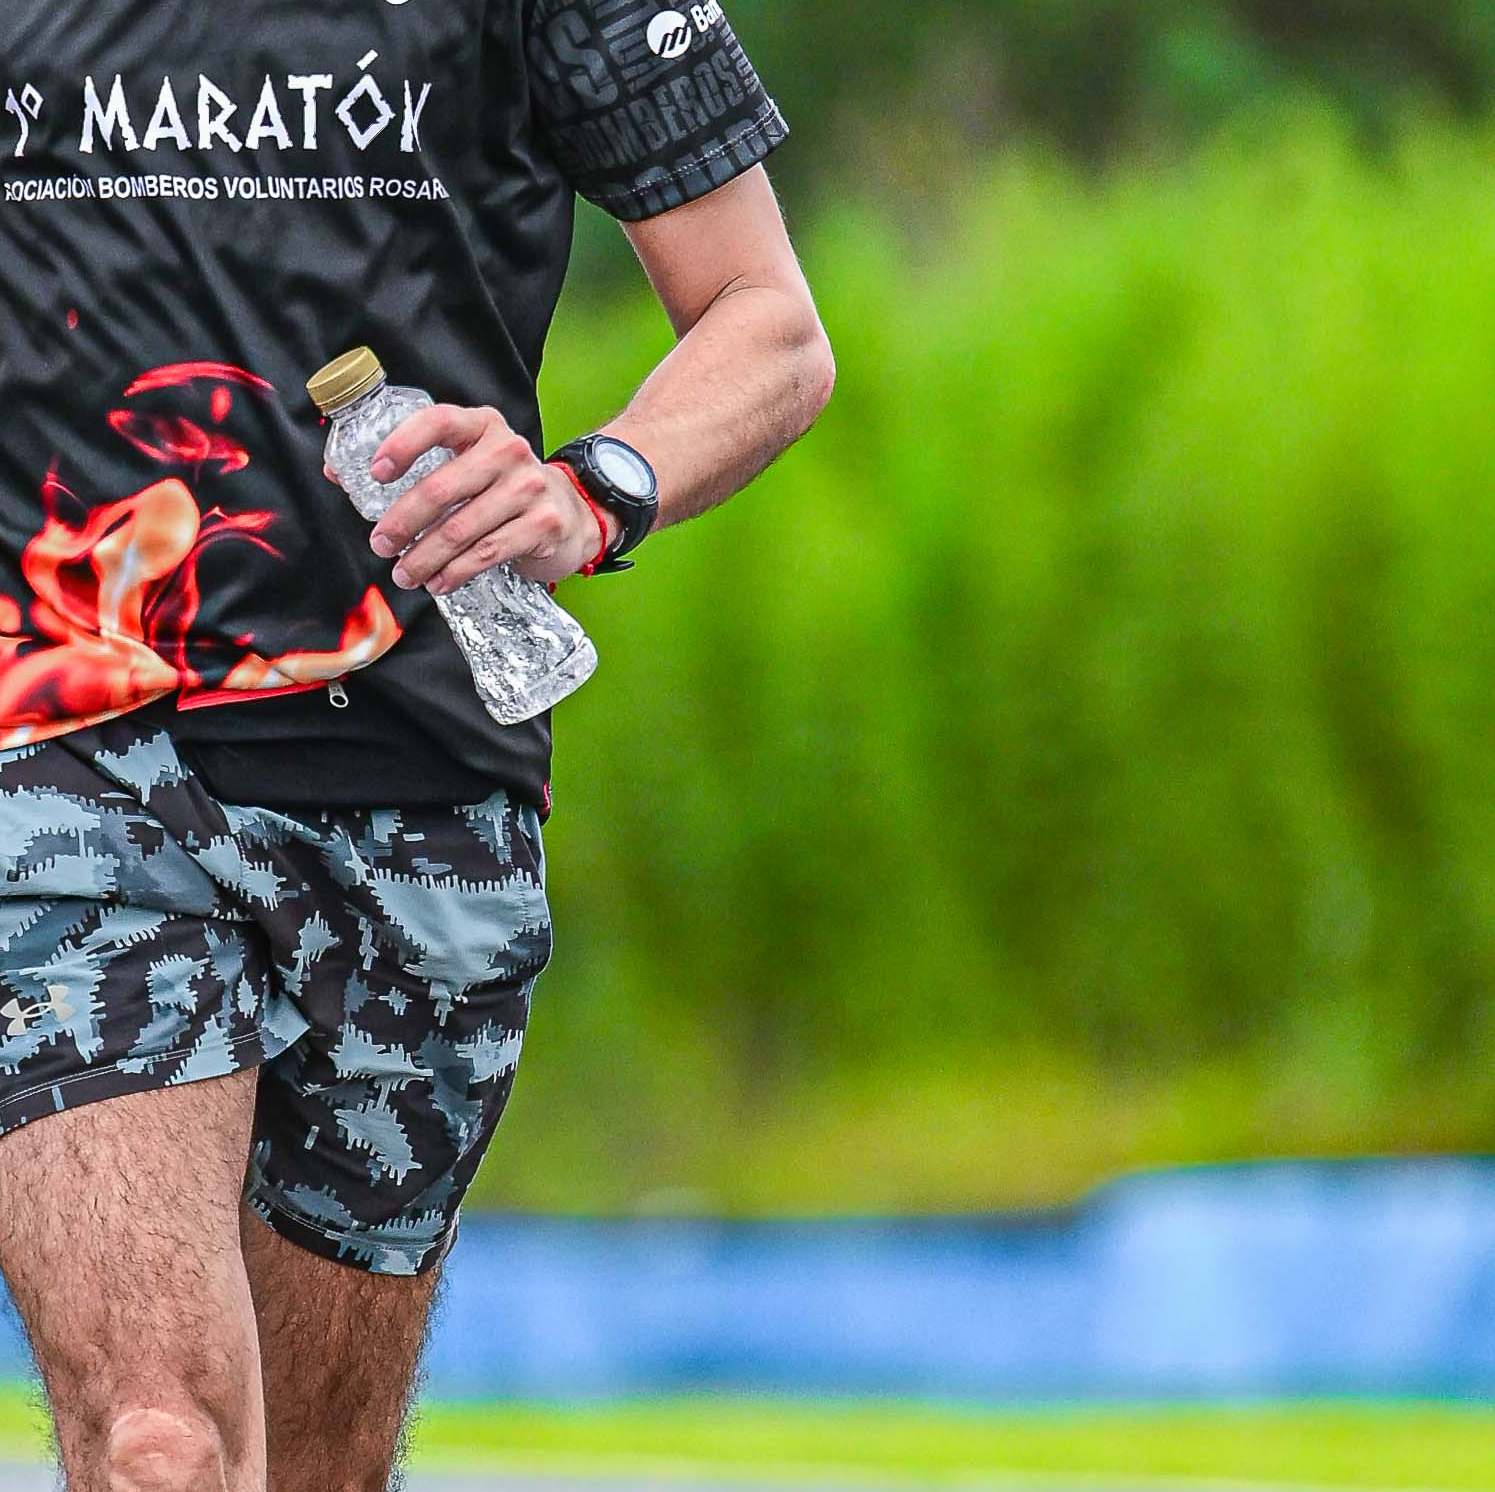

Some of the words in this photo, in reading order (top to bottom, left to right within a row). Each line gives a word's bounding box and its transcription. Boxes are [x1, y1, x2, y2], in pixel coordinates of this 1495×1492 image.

[98, 173, 219, 199] BOMBEROS
[223, 175, 365, 200] VOLUNTARIOS
[369, 177, 450, 201] ROSAR
